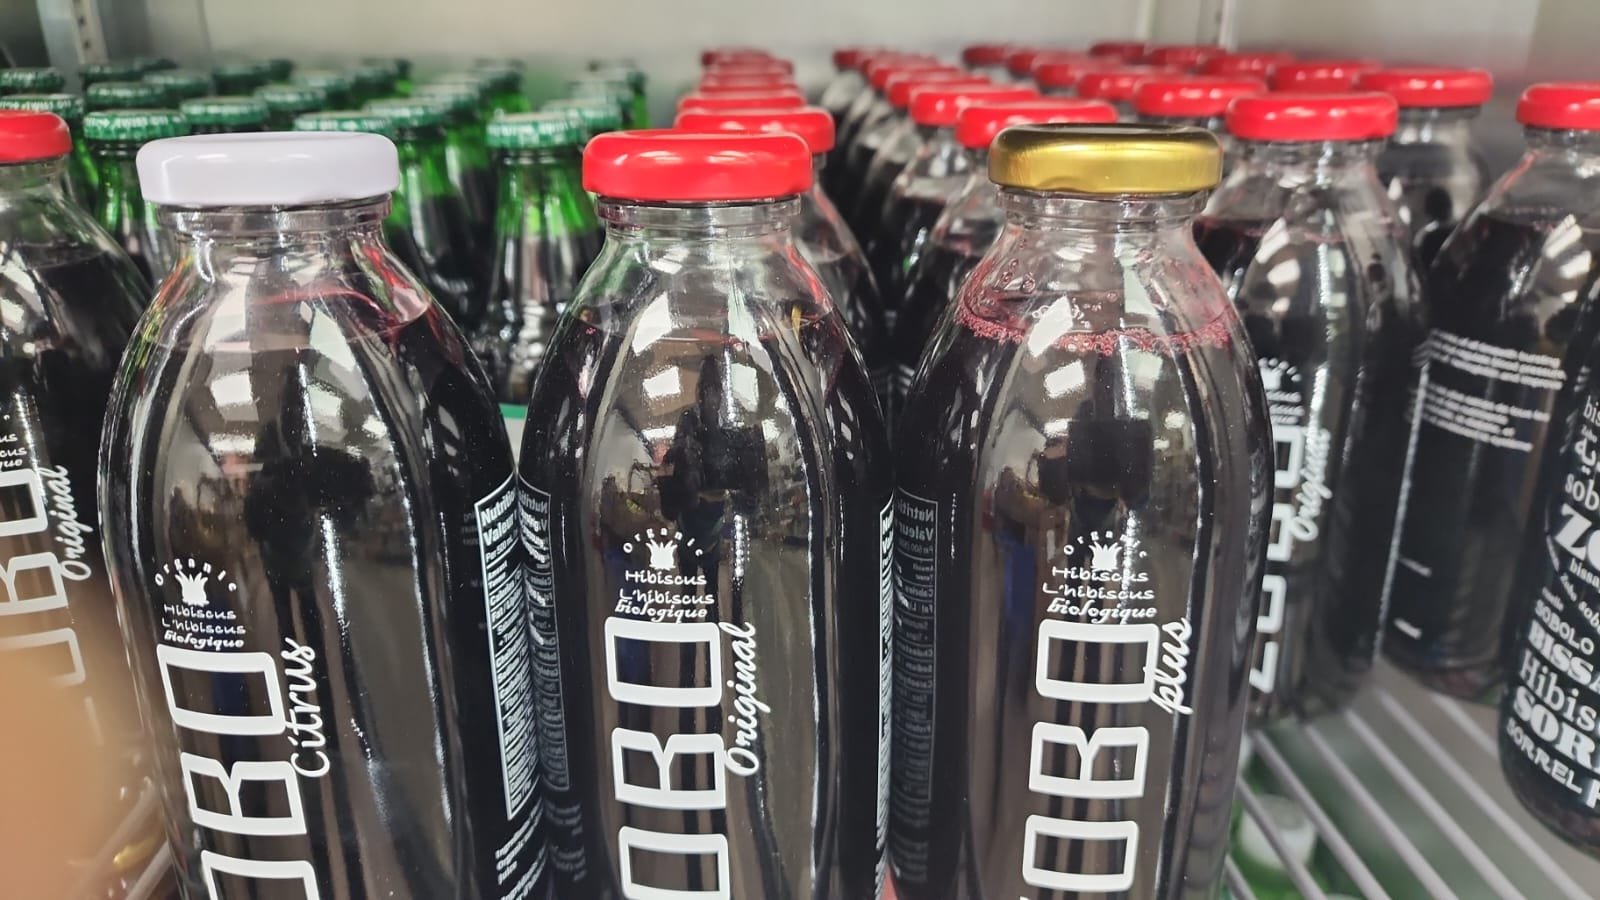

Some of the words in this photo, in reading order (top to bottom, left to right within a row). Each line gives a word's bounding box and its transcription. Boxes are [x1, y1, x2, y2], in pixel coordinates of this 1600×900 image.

[37, 464, 93, 580] Original
[163, 603, 237, 621] Hibiscus
[619, 588, 715, 606] L'hibiscus
[625, 569, 707, 586] Hibiscus
[1042, 582, 1155, 600] L'hibiscus
[1052, 566, 1149, 583] Hibiscus
[161, 618, 247, 636] L'hibiscus
[1143, 617, 1194, 715] plus
[281, 637, 331, 778] Citrus
[719, 621, 772, 777] Original
[1513, 685, 1600, 776] SOR
[1519, 649, 1600, 734] Hibis
[1506, 716, 1583, 795] SORREL
